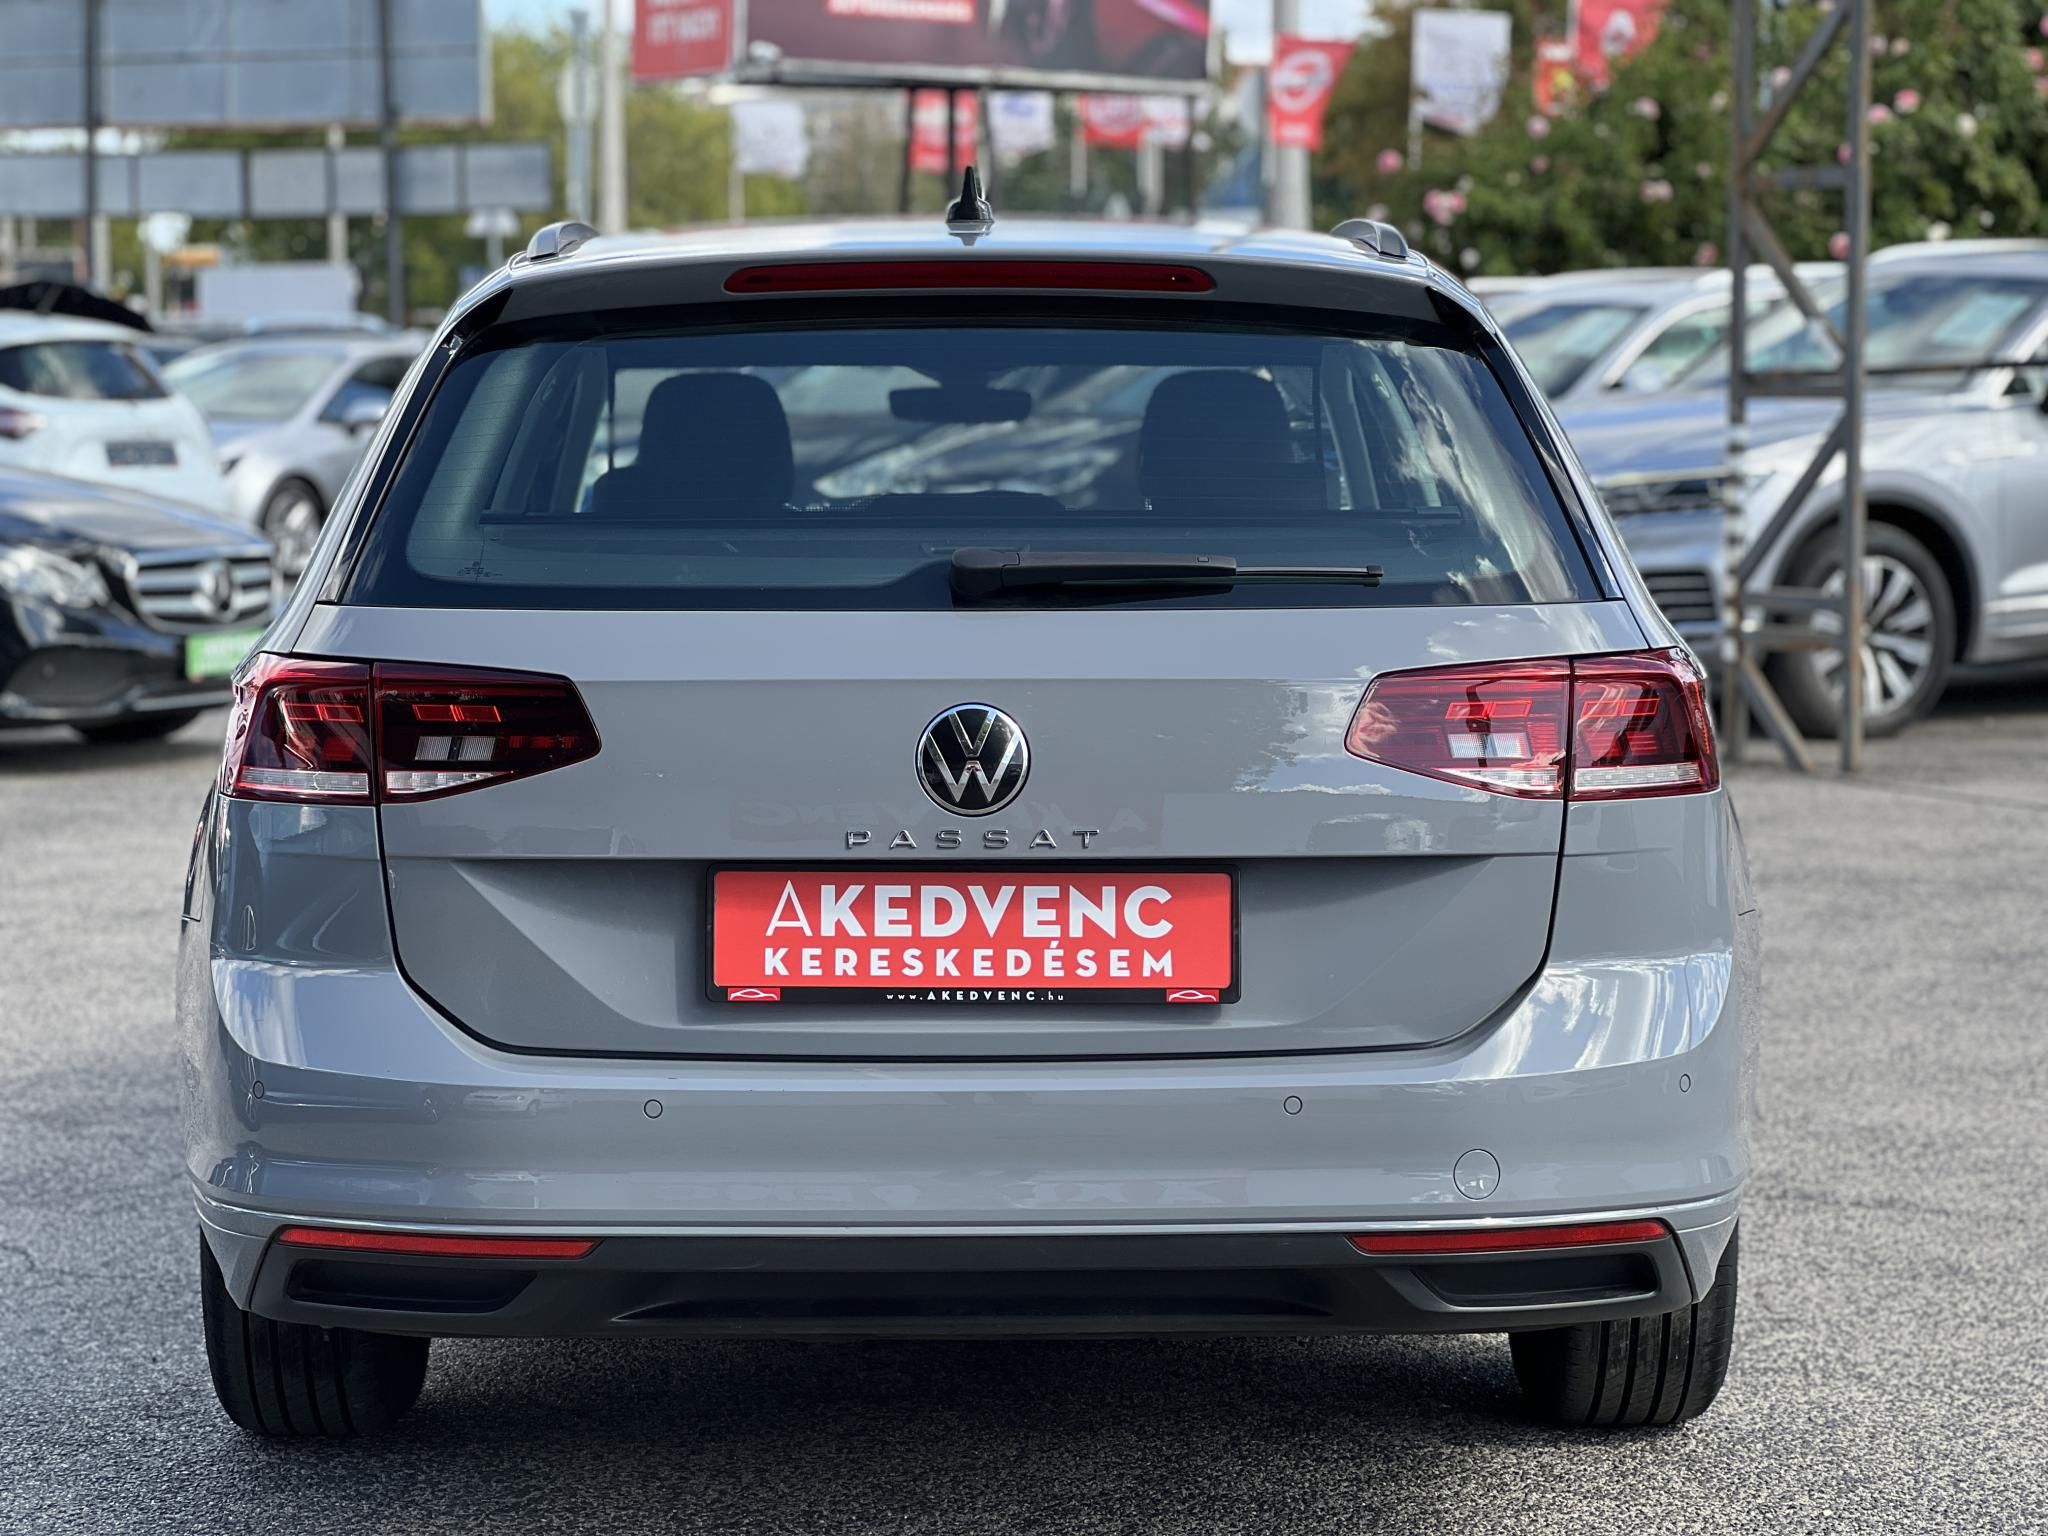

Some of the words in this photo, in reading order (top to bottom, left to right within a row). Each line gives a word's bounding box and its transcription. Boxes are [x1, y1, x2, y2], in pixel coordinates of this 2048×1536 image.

[846, 829, 1100, 850] PASSAT
[765, 880, 1174, 939] AKEDVENC
[765, 942, 1174, 977] KERESKEDÉSEM
[886, 990, 1065, 1001] www.AKEDVENC.hu
